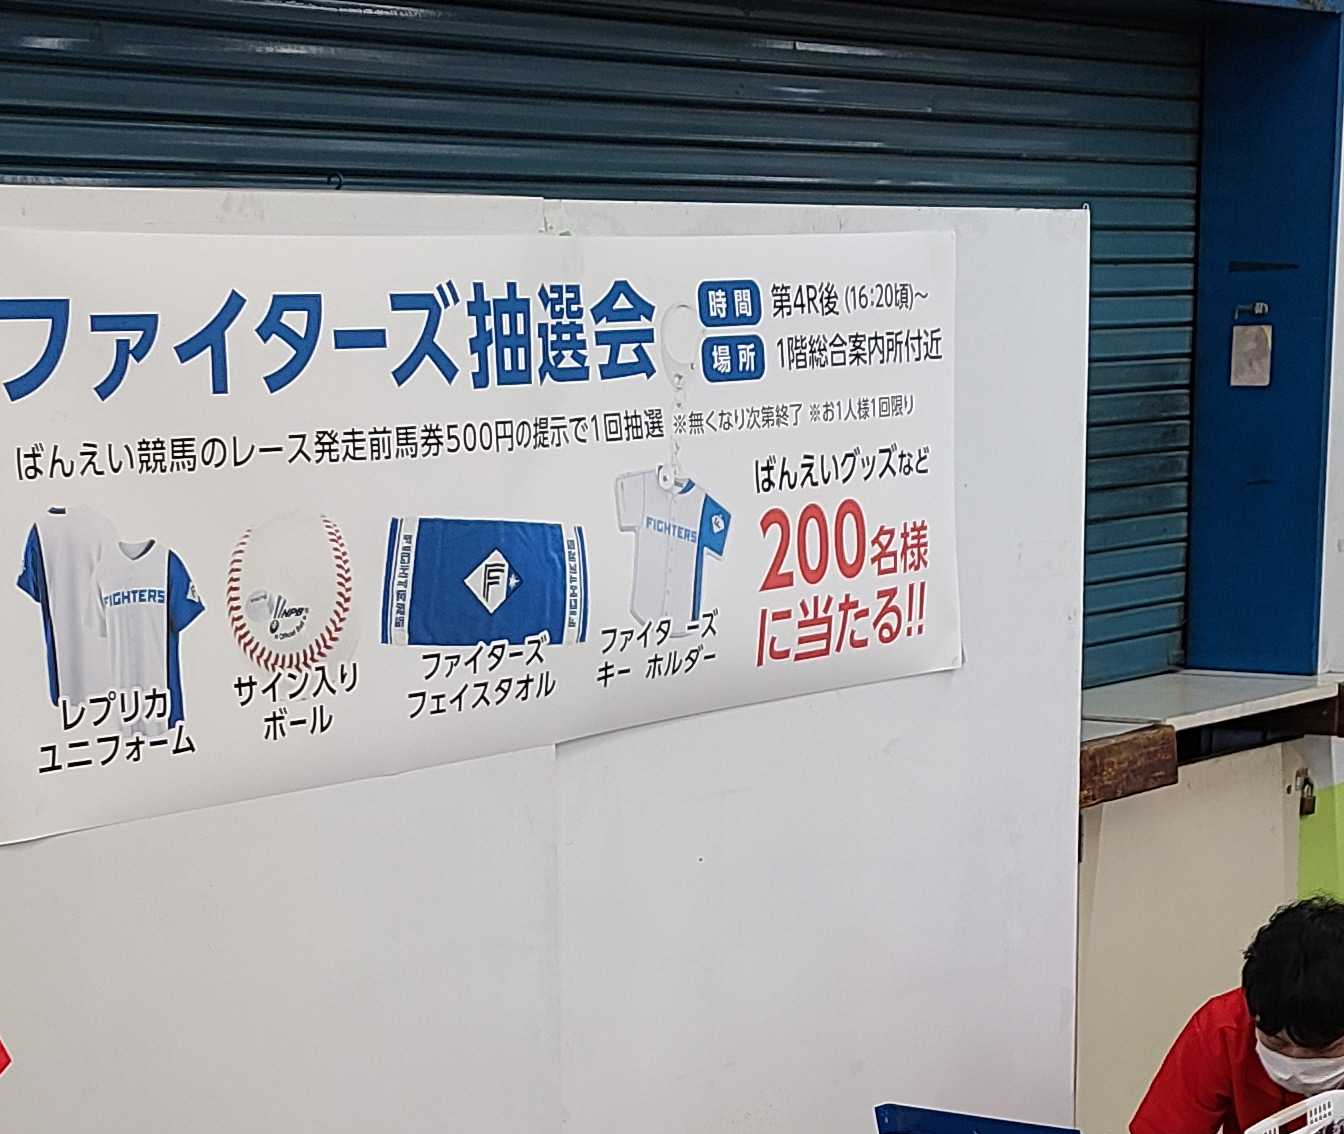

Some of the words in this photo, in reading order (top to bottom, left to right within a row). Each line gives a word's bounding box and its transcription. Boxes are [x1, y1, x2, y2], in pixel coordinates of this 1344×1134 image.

[707, 288, 752, 319] 時間
[770, 281, 840, 321] 第4R後
[712, 343, 757, 375] 場所
[776, 328, 943, 372] 1階総合案内所付近
[16, 409, 665, 480] ばんえい競馬のレース発走前馬券500円の提示で1回抽選
[755, 445, 930, 494] ばんえいグッズなど
[646, 516, 698, 543] FIGHTERS
[758, 498, 929, 592] 200名様
[104, 588, 165, 606] FIGHTERS
[600, 608, 718, 655] ファイターズ
[756, 580, 927, 667] に当たる!!
[422, 635, 551, 681] ファイターズ
[233, 663, 358, 707] サイン入り
[407, 671, 556, 720] フェイスタオル
[61, 689, 170, 732] レプリカ
[263, 705, 334, 742] ボール
[38, 724, 196, 774] ユニフォーム
